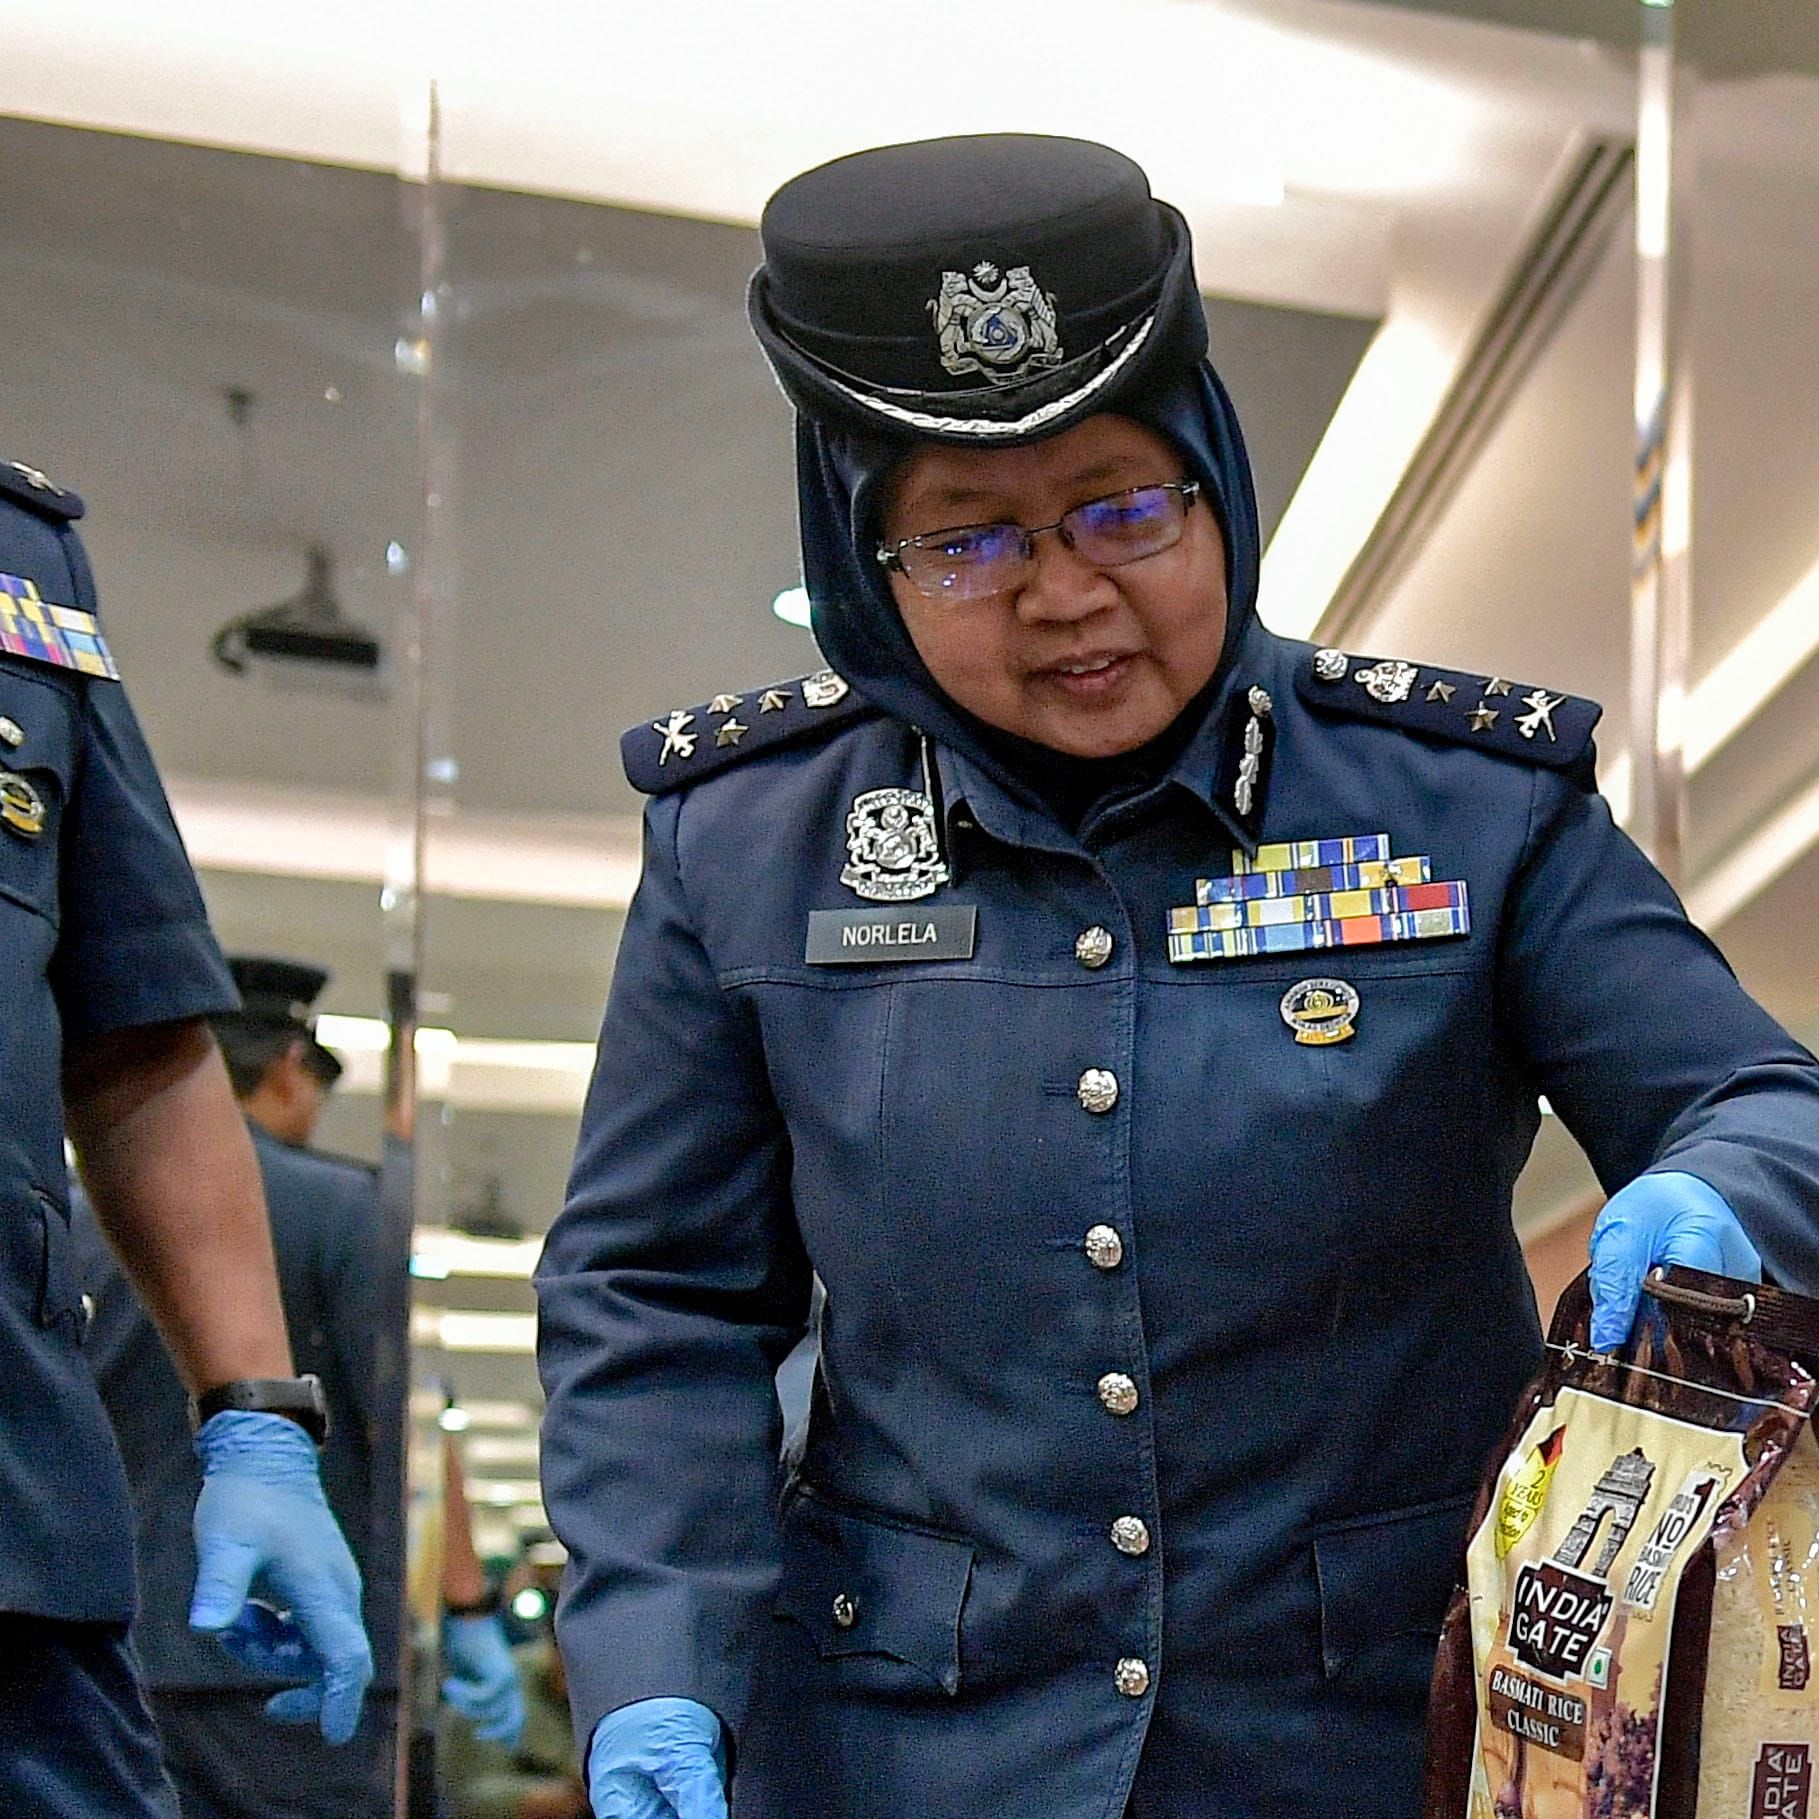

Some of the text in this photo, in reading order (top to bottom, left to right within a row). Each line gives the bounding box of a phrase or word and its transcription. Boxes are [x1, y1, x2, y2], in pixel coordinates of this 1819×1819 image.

[842, 923, 937, 946] NORLELA
[1531, 1469, 1546, 1489] 2
[1518, 1576, 1602, 1632] INDIA
[1624, 1566, 1662, 1605] RICE
[1516, 1612, 1590, 1663] GATE
[1492, 1670, 1583, 1725] BASMATI RICE
[1507, 1709, 1560, 1747] CLASSIC
